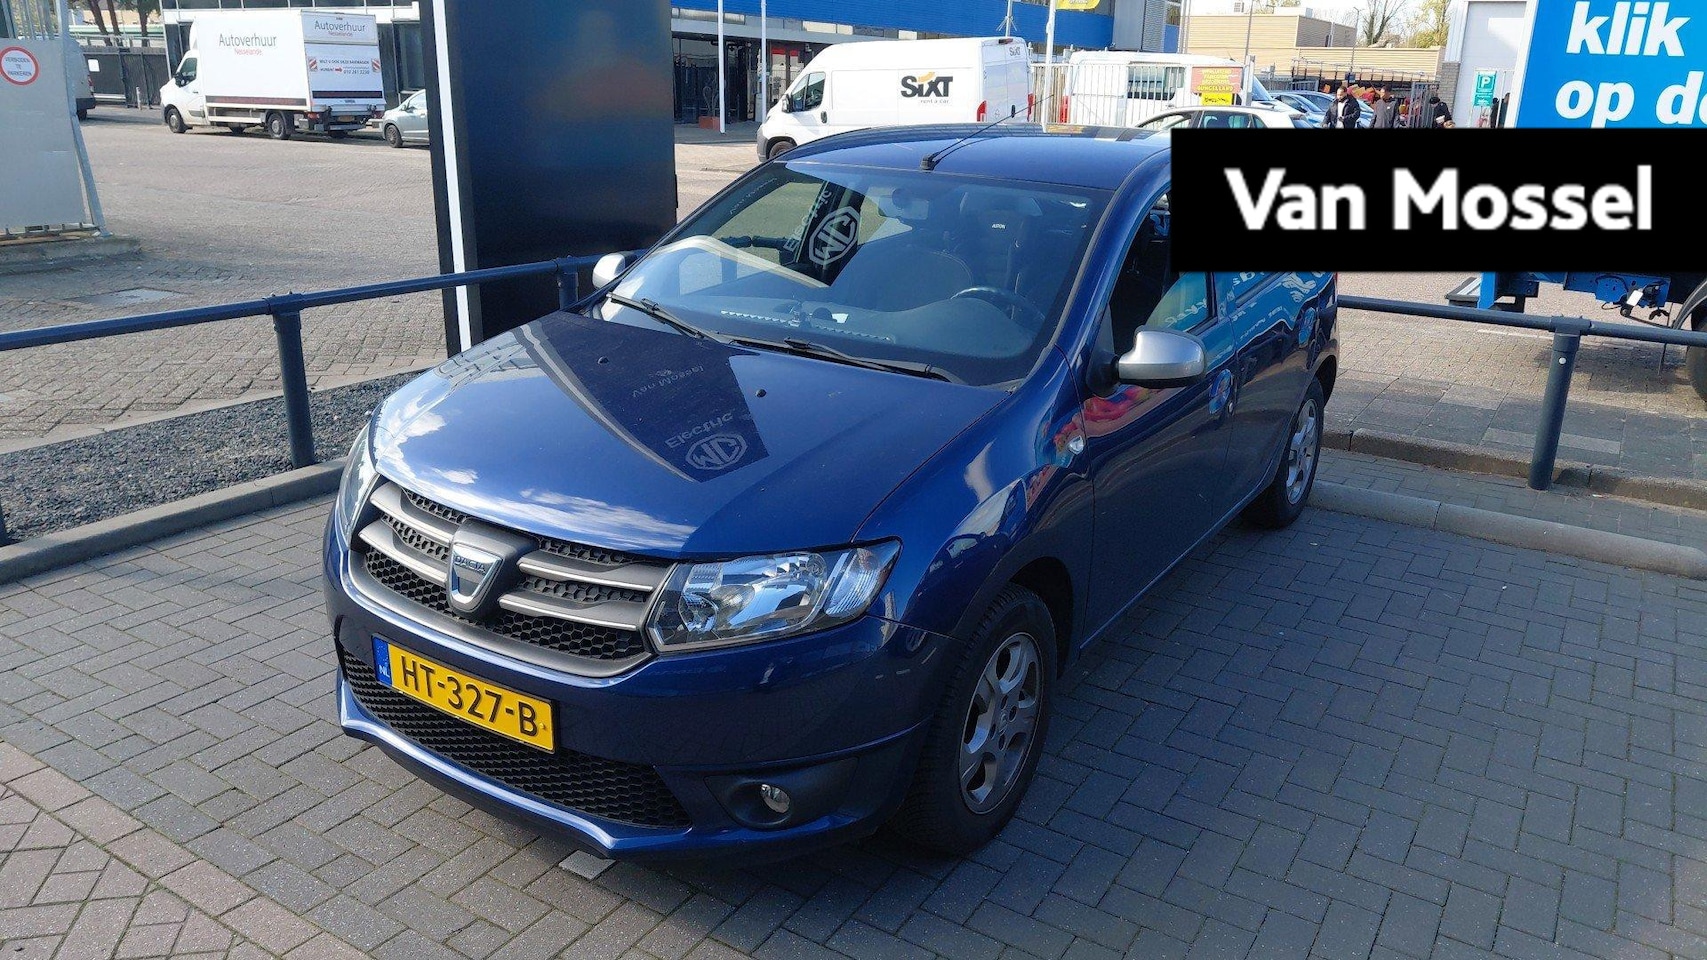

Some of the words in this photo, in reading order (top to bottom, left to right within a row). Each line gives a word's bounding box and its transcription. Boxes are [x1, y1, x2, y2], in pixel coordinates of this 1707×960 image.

[314, 21, 366, 32] Autoverhuur
[1566, 1, 1691, 57] klik
[219, 33, 277, 47] Autoverhuur
[1481, 76, 1491, 88] P
[1555, 80, 1635, 128] op
[454, 555, 487, 574] DACIA
[379, 664, 390, 679] NL
[400, 654, 539, 737] HT-327-B
